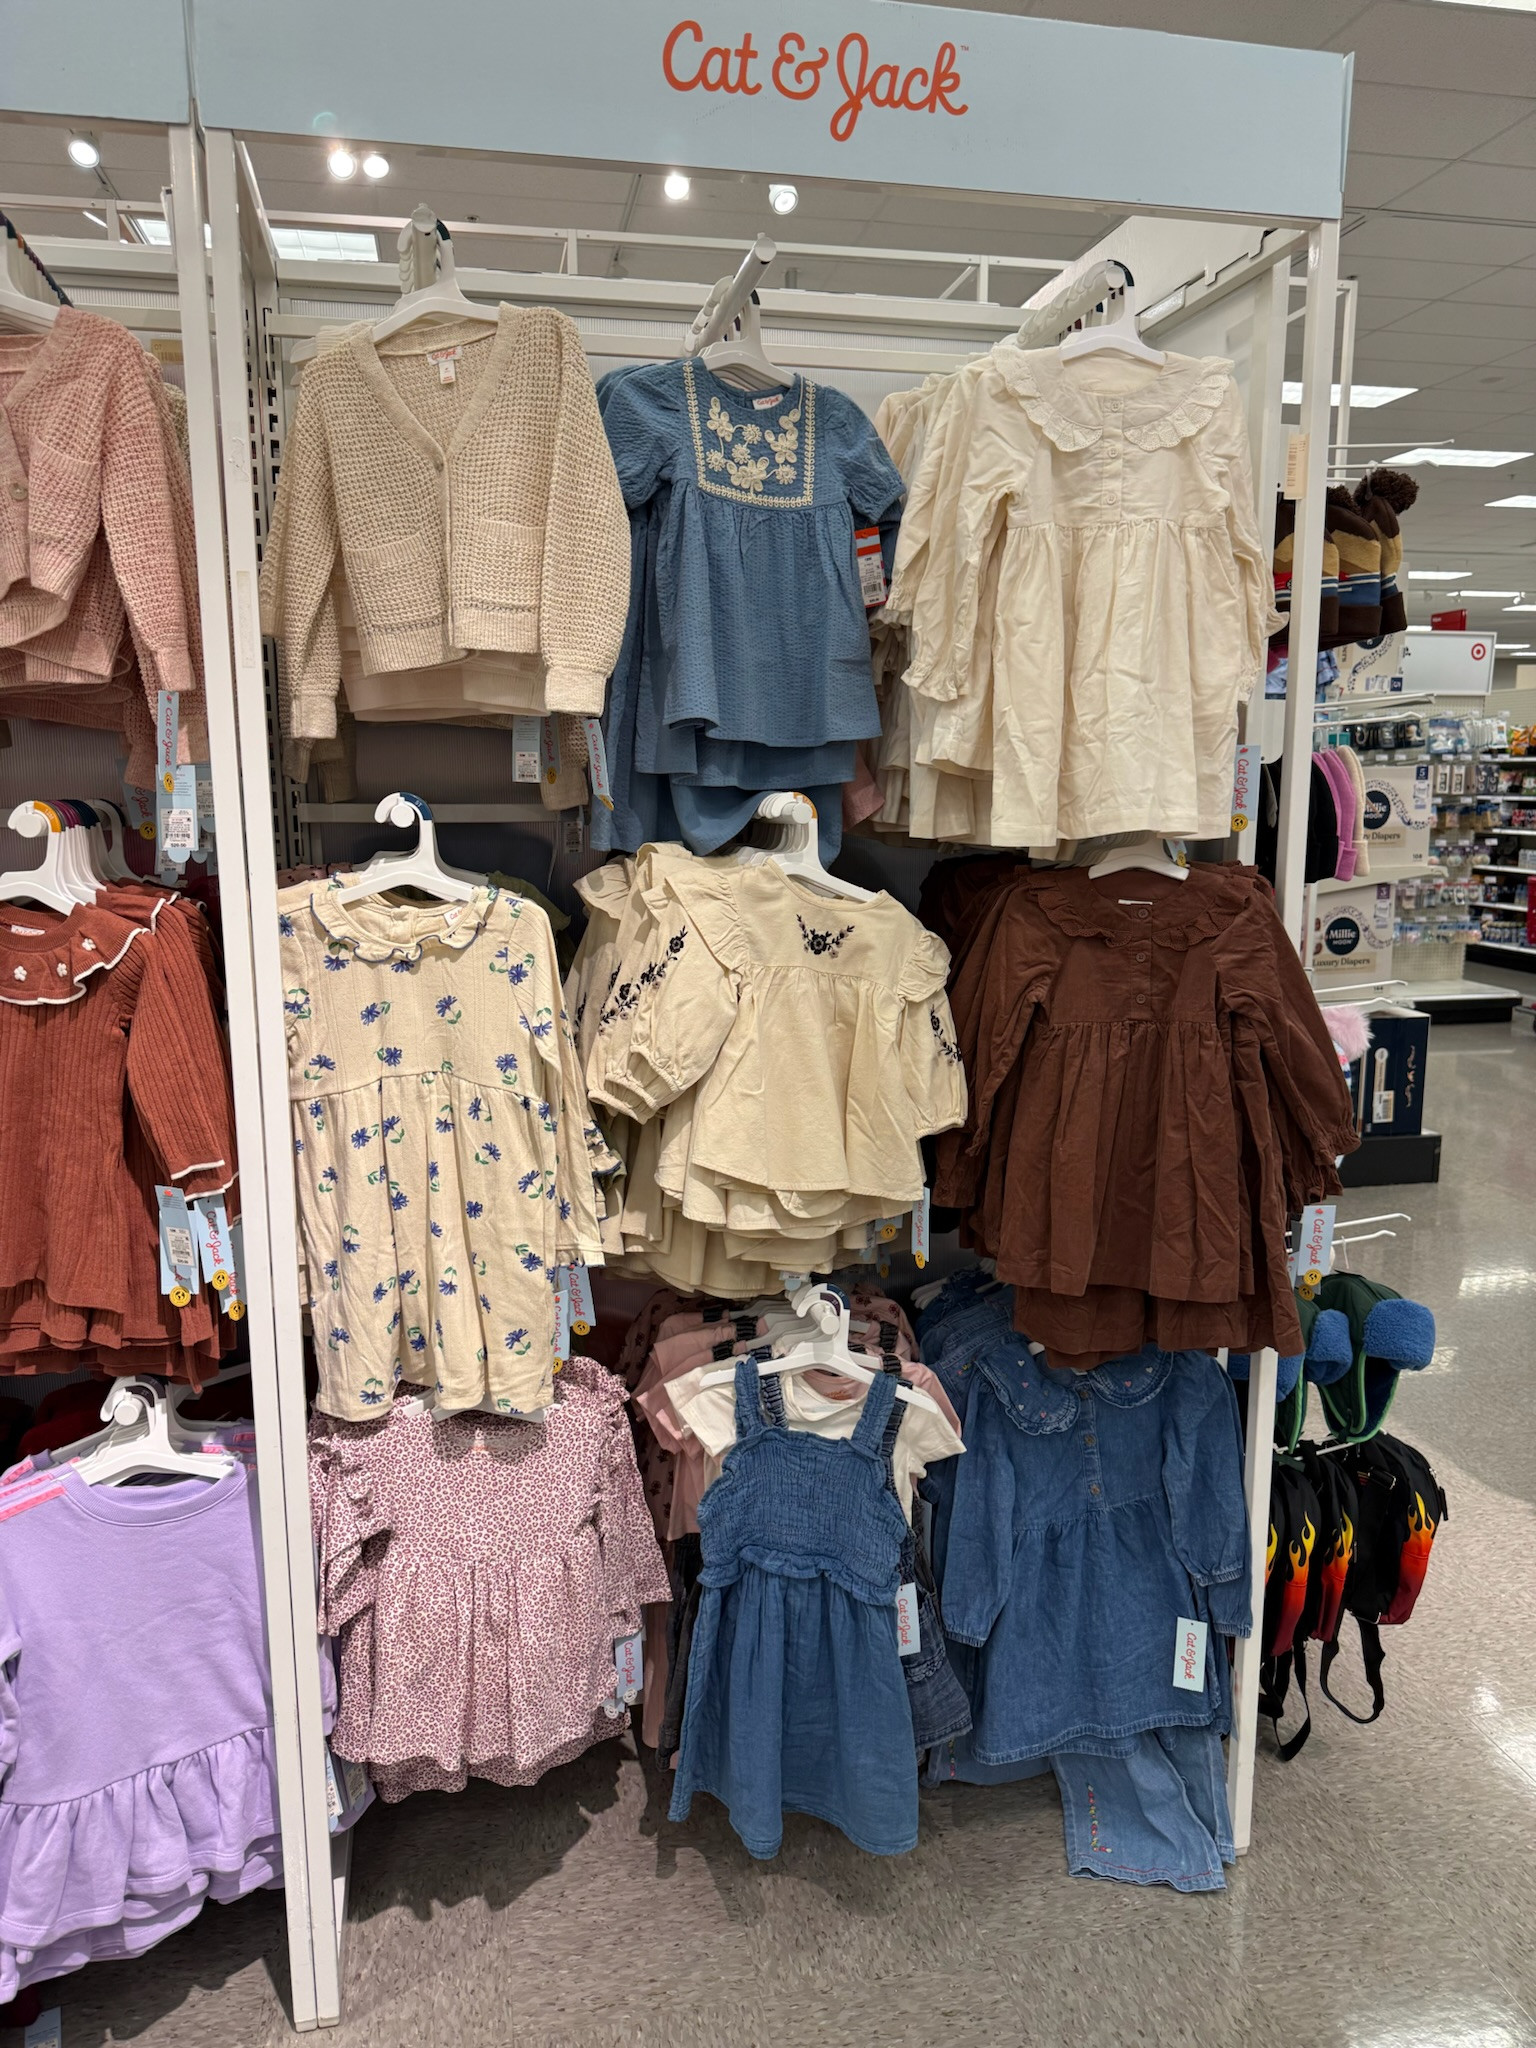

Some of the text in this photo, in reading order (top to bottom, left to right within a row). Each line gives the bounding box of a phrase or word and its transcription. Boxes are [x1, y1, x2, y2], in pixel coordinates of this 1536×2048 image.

[662, 20, 762, 96] Cat
[772, 32, 829, 101] &
[830, 33, 969, 142] Jack
[162, 707, 173, 767] Cat & Jack
[594, 753, 601, 763] &
[593, 763, 604, 789] Jack
[1234, 758, 1249, 811] Cat & Jack
[1419, 768, 1426, 777] 5
[131, 797, 153, 819] Jack
[1372, 832, 1401, 841] Diapers
[1380, 886, 1387, 896] 3
[1329, 929, 1357, 939] Millie
[1312, 957, 1371, 967] Luxury Diapers
[205, 1211, 225, 1267] Cat & Jack
[1306, 1218, 1324, 1266] Cat & Jack
[569, 1273, 585, 1317] Cat & Jack
[898, 1598, 912, 1647] Cat & Jack
[622, 1642, 635, 1686] Cat & Jack
[1181, 1632, 1197, 1680] Cat & Jack
